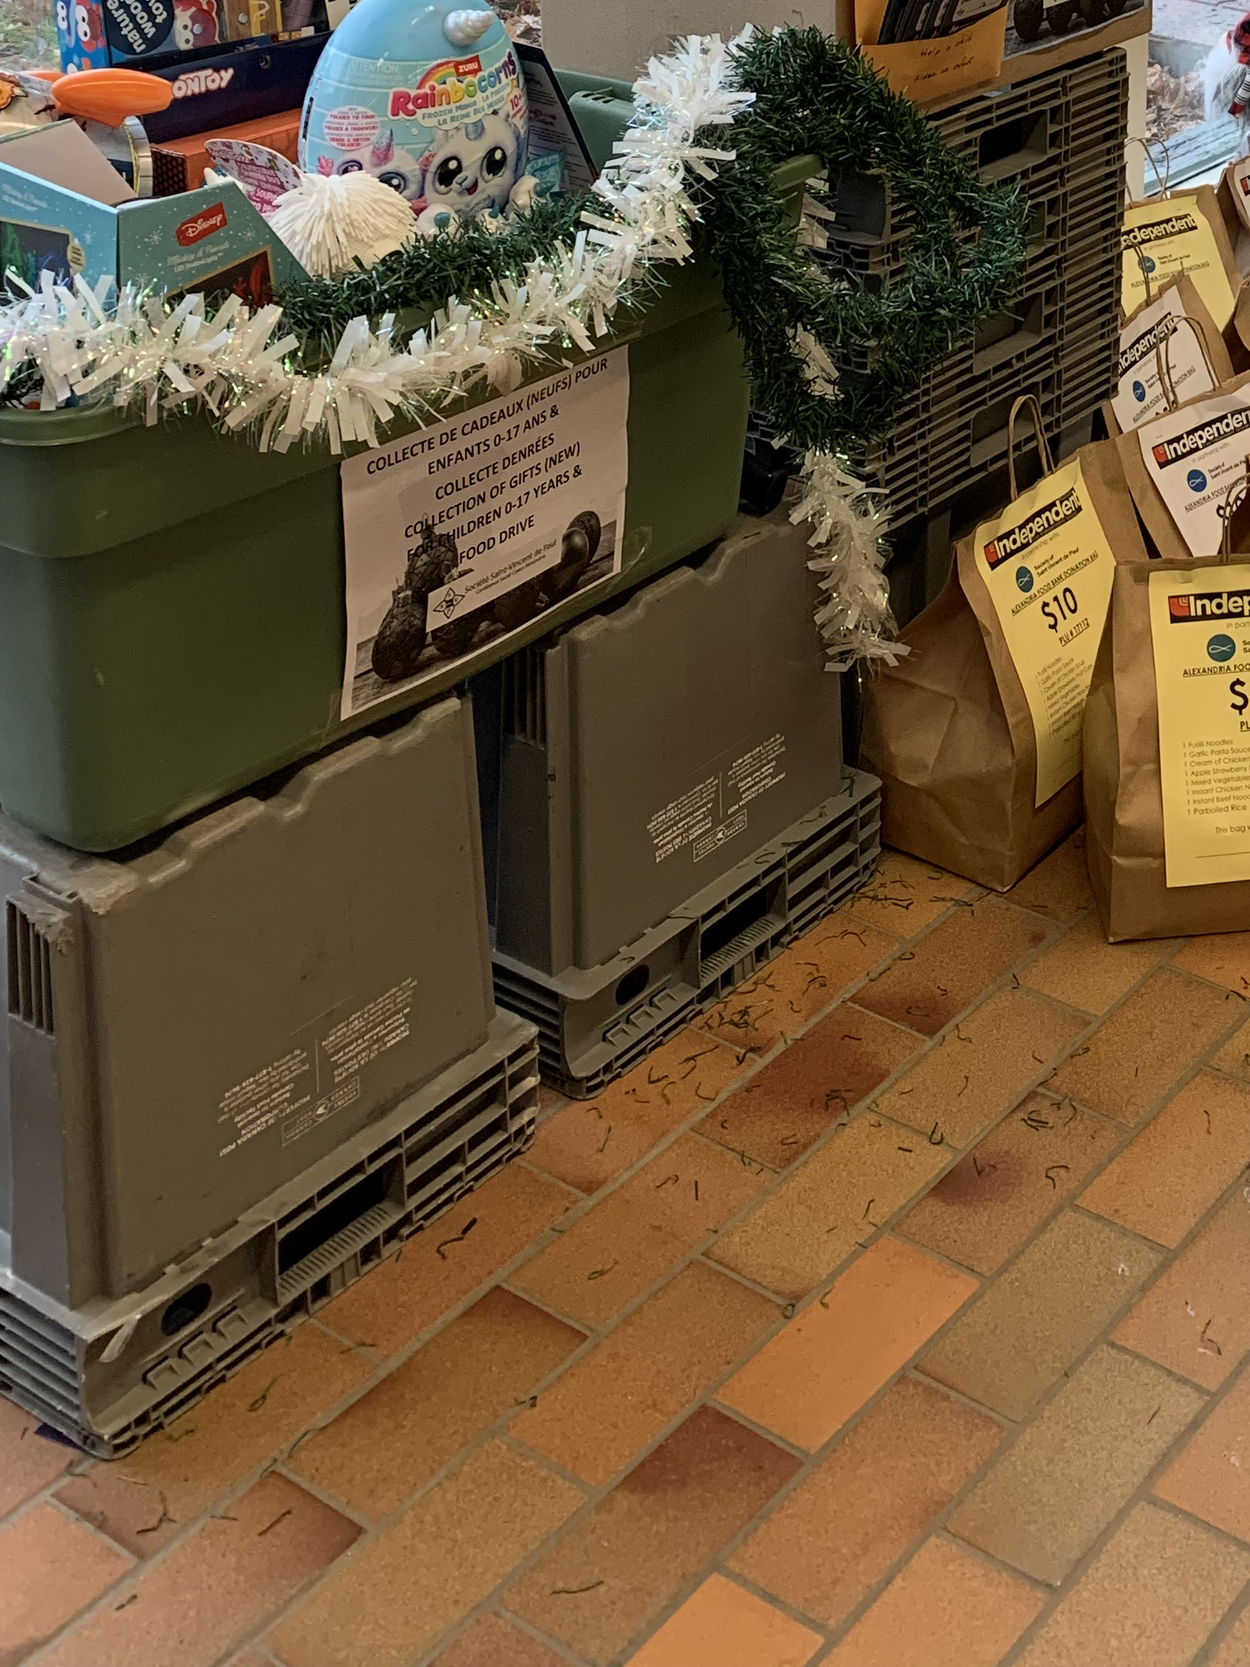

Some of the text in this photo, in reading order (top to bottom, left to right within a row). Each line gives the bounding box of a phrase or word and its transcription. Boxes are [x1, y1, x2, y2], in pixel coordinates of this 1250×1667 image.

[391, 51, 517, 117] Rainbocorns
[458, 62, 478, 72] ZURU
[422, 107, 453, 120] FROZEN
[367, 358, 607, 474] COLLECTE DE CADEAUX (NEUFS) POUR
[428, 405, 559, 475] ENFANTS 0-17 ANS &
[405, 442, 581, 538] COLLECTION OF GIFTS (NEW)
[435, 433, 554, 500] COLLECTE DENRÉES
[407, 465, 582, 562] FOR CHILDREN 0-17 YEARS &
[995, 490, 1080, 559] Independent
[460, 514, 535, 563] FOOD DRIVE
[534, 548, 542, 557] de
[1041, 587, 1078, 633] $10
[1183, 665, 1231, 676] ALEXANDRIA
[1213, 775, 1250, 784] Vegetables
[1194, 806, 1229, 815] Parboiled
[1216, 826, 1227, 834] This
[1230, 824, 1245, 833] bag
